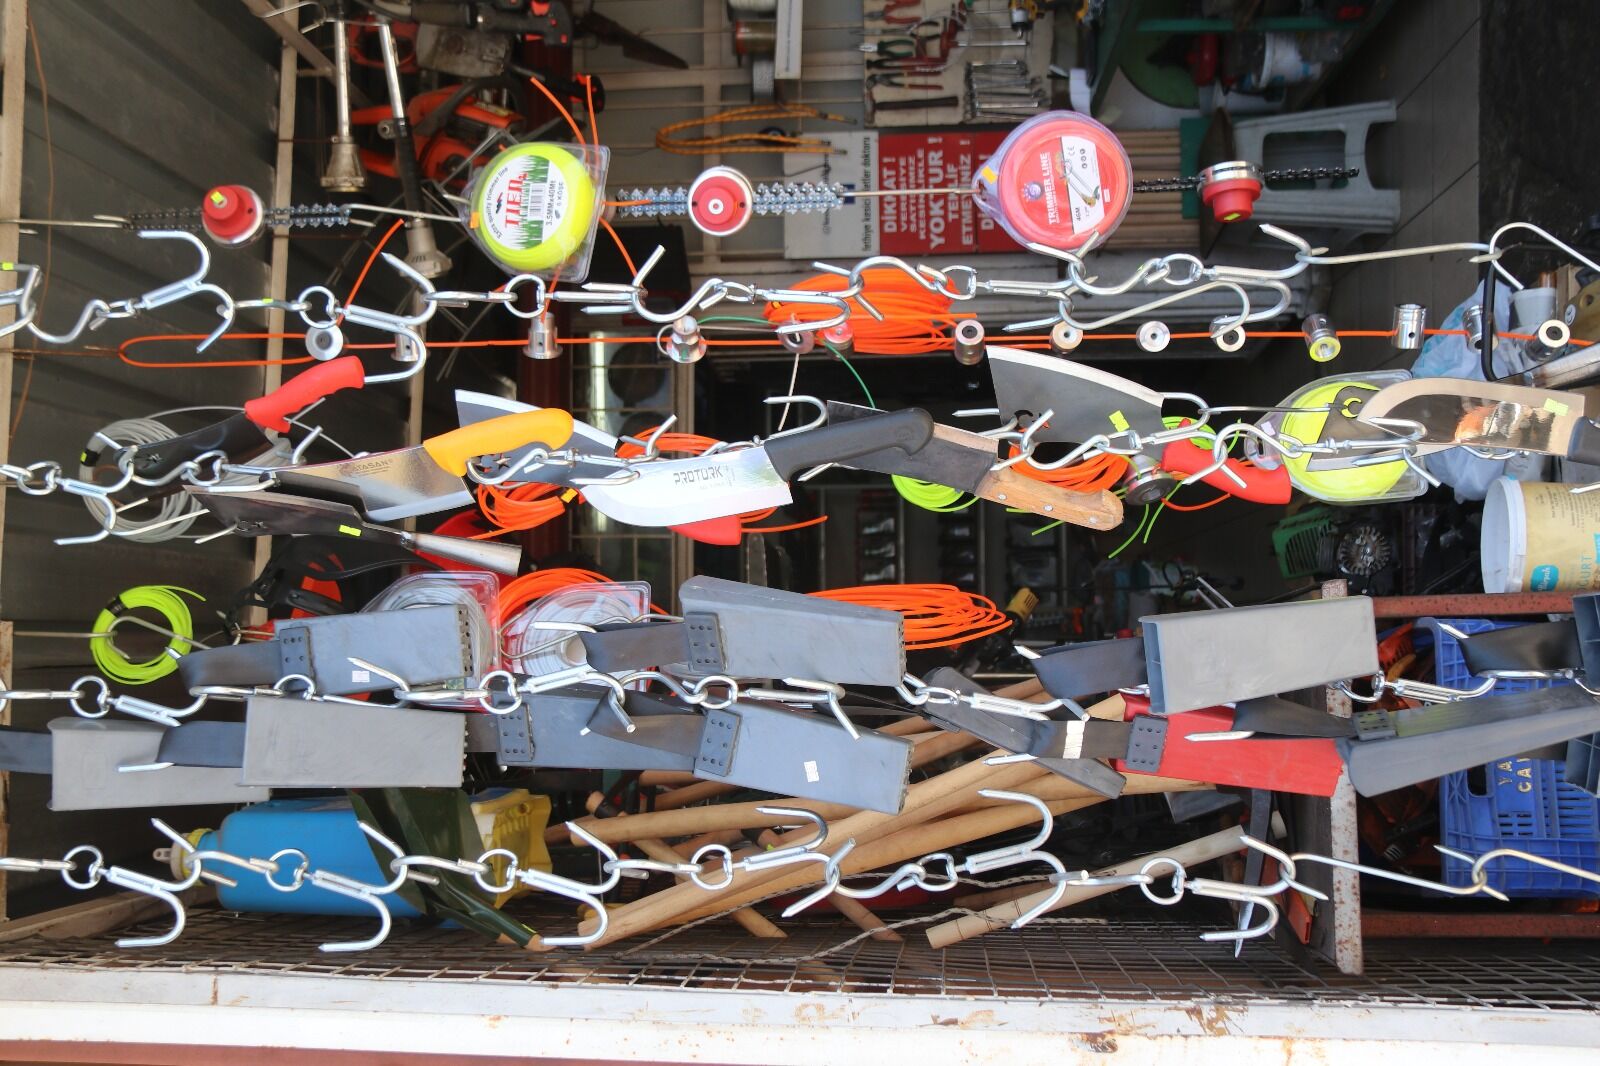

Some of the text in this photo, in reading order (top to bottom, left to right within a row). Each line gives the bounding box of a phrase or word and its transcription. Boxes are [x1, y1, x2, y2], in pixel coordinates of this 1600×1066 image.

[863, 137, 871, 167] doktoru
[929, 136, 943, 144] !
[1040, 152, 1050, 177] LINE
[862, 170, 870, 194] letler
[946, 163, 959, 222] TEKLİF
[1043, 179, 1057, 225] TRIMMER
